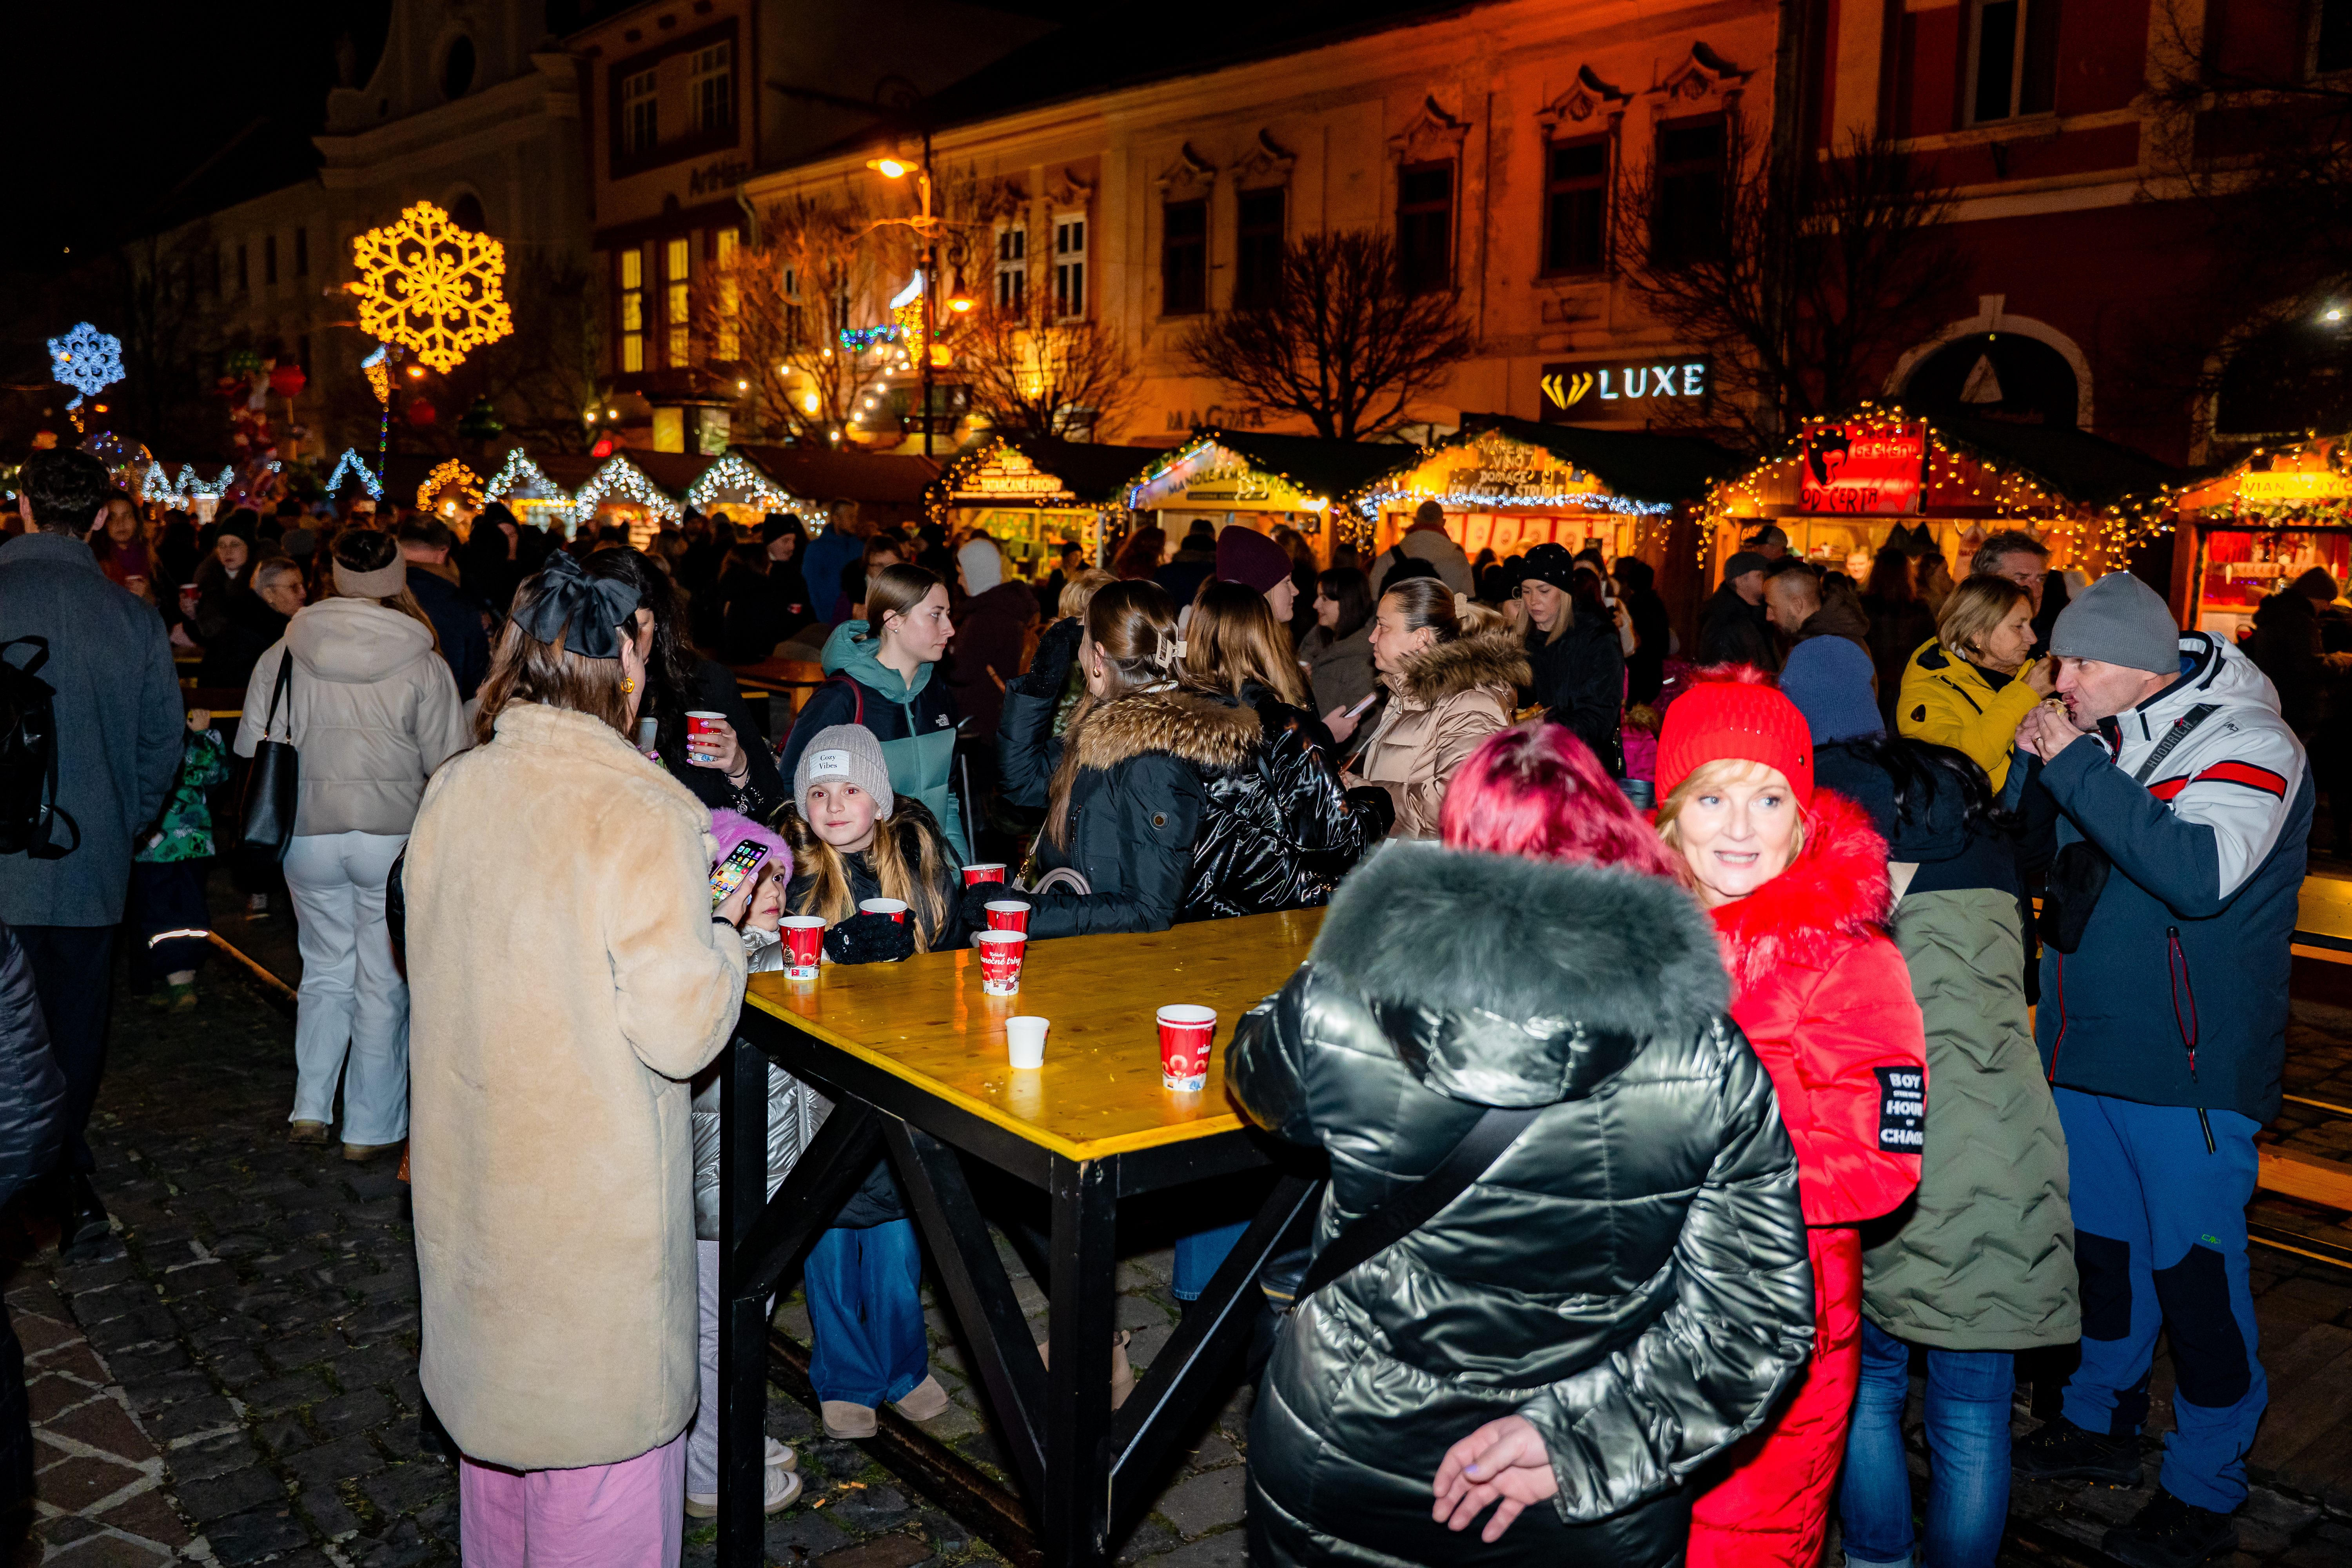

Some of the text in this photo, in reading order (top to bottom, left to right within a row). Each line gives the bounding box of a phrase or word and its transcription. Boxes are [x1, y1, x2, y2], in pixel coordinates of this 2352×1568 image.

[1599, 364, 1705, 399] LUXE
[1801, 488, 1821, 510] OD
[2147, 719, 2194, 768] HOODRICH
[980, 954, 1021, 966] ianočné trhy
[1889, 1073, 1921, 1089] BOY
[2201, 1234, 2221, 1244] CMP
